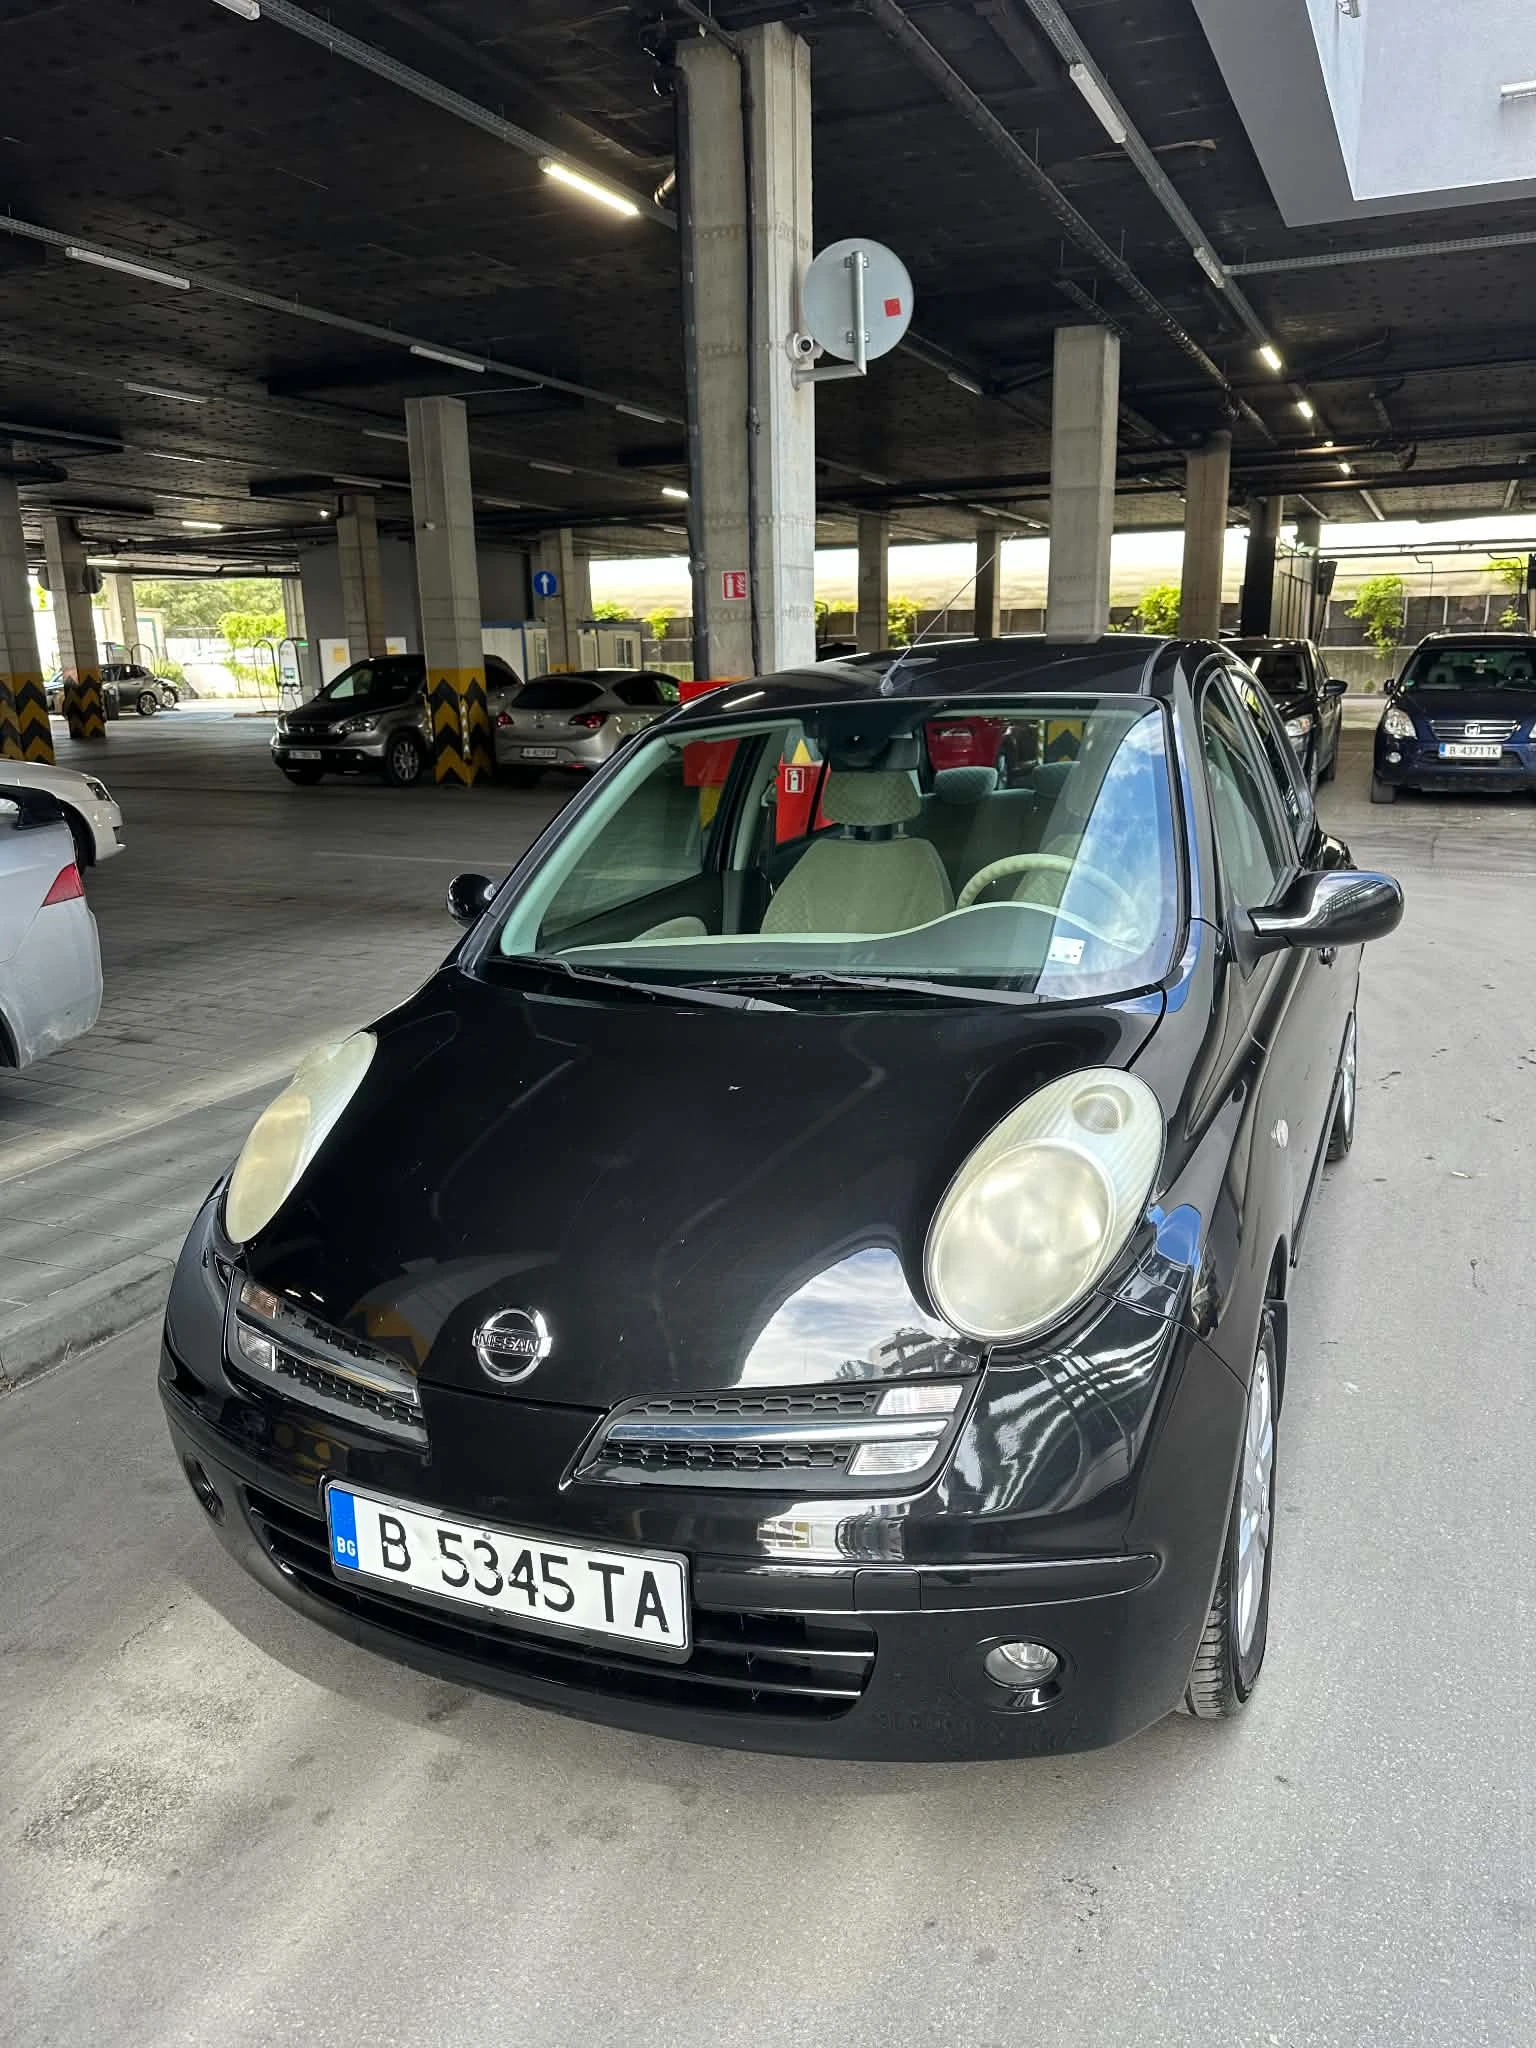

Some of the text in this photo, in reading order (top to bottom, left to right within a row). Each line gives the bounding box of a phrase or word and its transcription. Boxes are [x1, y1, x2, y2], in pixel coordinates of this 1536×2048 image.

[1487, 746, 1499, 755] TK
[477, 1332, 539, 1353] NISSAN
[336, 1536, 356, 1557] BG
[378, 1513, 671, 1633] B 5345 TA
